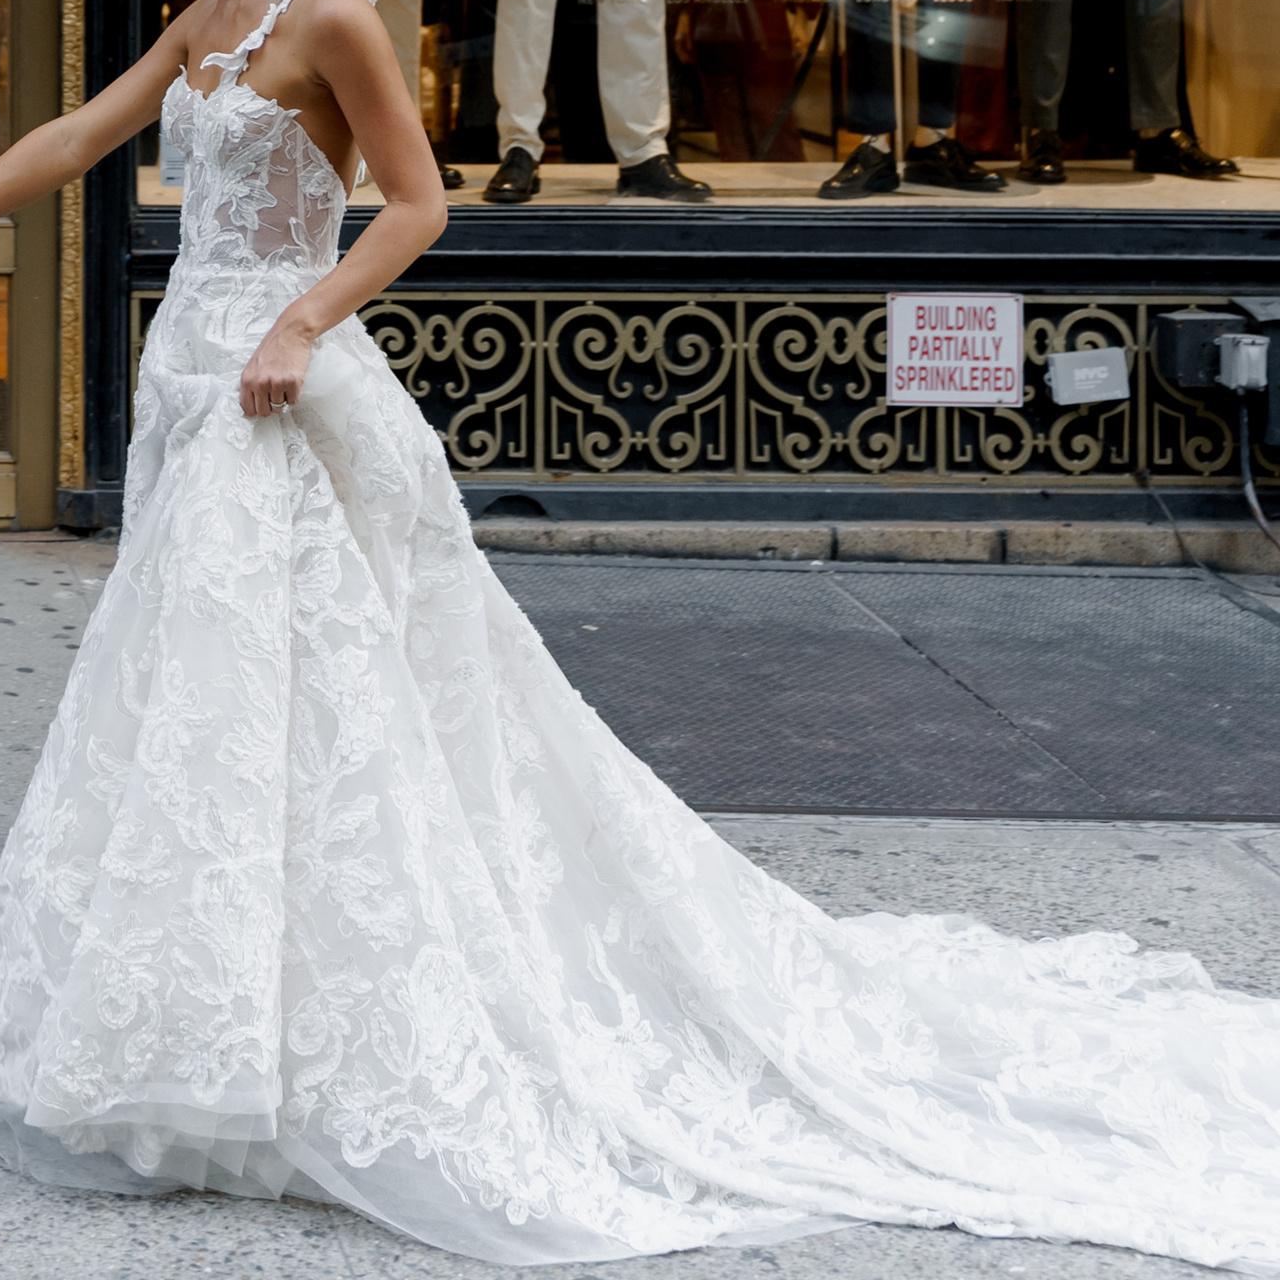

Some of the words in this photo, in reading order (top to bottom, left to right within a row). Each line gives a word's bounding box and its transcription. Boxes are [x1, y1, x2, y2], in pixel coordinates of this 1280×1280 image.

[915, 306, 997, 331] BUILDING
[908, 336, 1004, 361] PARTIALLY
[894, 365, 1016, 392] SPRINKLERED
